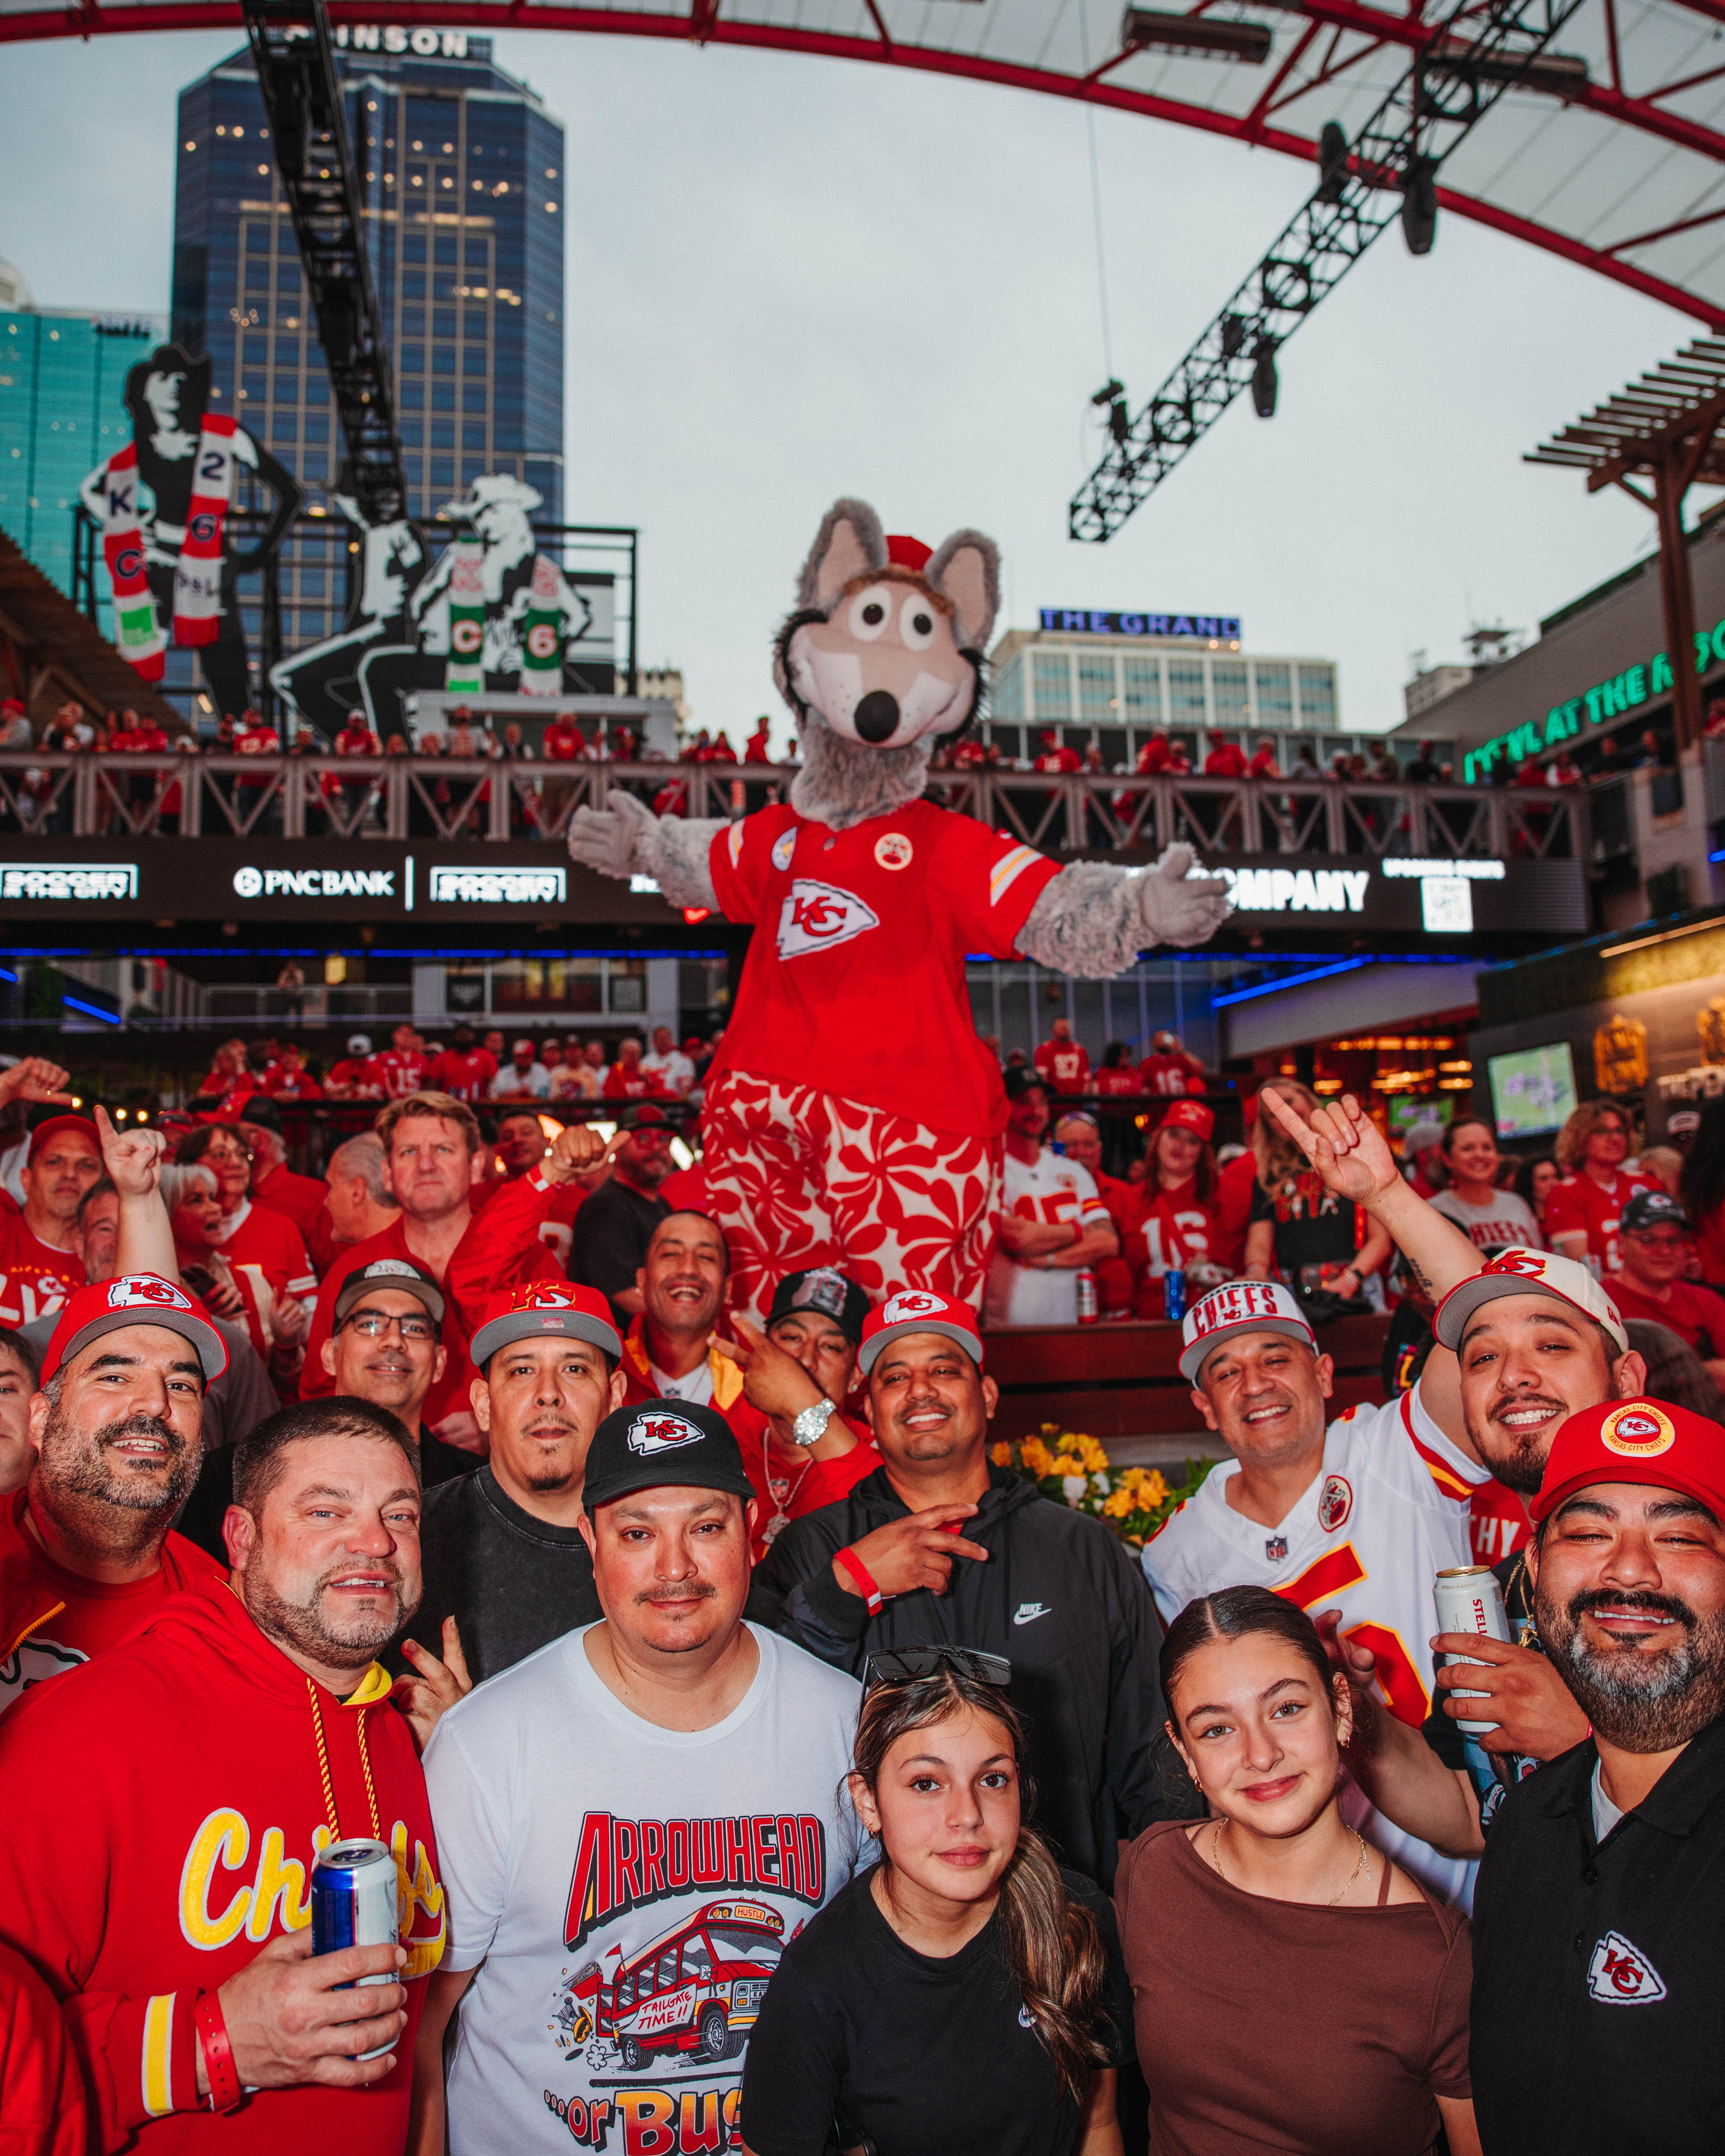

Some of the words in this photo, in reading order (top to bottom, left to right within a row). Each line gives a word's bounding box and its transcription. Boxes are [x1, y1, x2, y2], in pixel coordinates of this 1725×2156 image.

[284, 24, 468, 58] INSON
[201, 452, 225, 480] 2
[108, 485, 132, 516] K
[190, 514, 215, 542] 6
[116, 549, 142, 580] C
[451, 619, 483, 653] C
[1041, 609, 1111, 634] THE
[1119, 613, 1240, 637] GRAND
[527, 623, 558, 658] 6
[1584, 663, 1647, 724] THE
[1186, 867, 1370, 912] MPANY
[1468, 1221, 1535, 1248] HIEFS
[129, 1280, 174, 1302] KC
[1193, 1287, 1278, 1337] CHIEFS
[644, 1419, 688, 1442] KC
[1610, 1407, 1631, 1423] KANSAS
[1648, 1408, 1667, 1426] CHIEFS
[1627, 1421, 1649, 1432] KC
[1608, 1435, 1627, 1450] KANSAS
[1645, 1437, 1666, 1451] CHIEFS
[1018, 1602, 1043, 1616] NIKE
[563, 1811, 826, 1953] ARROWHEAD
[737, 1908, 763, 1919] HUSTLE
[1601, 1948, 1644, 1995] KC
[642, 1991, 692, 2014] TAILGATE
